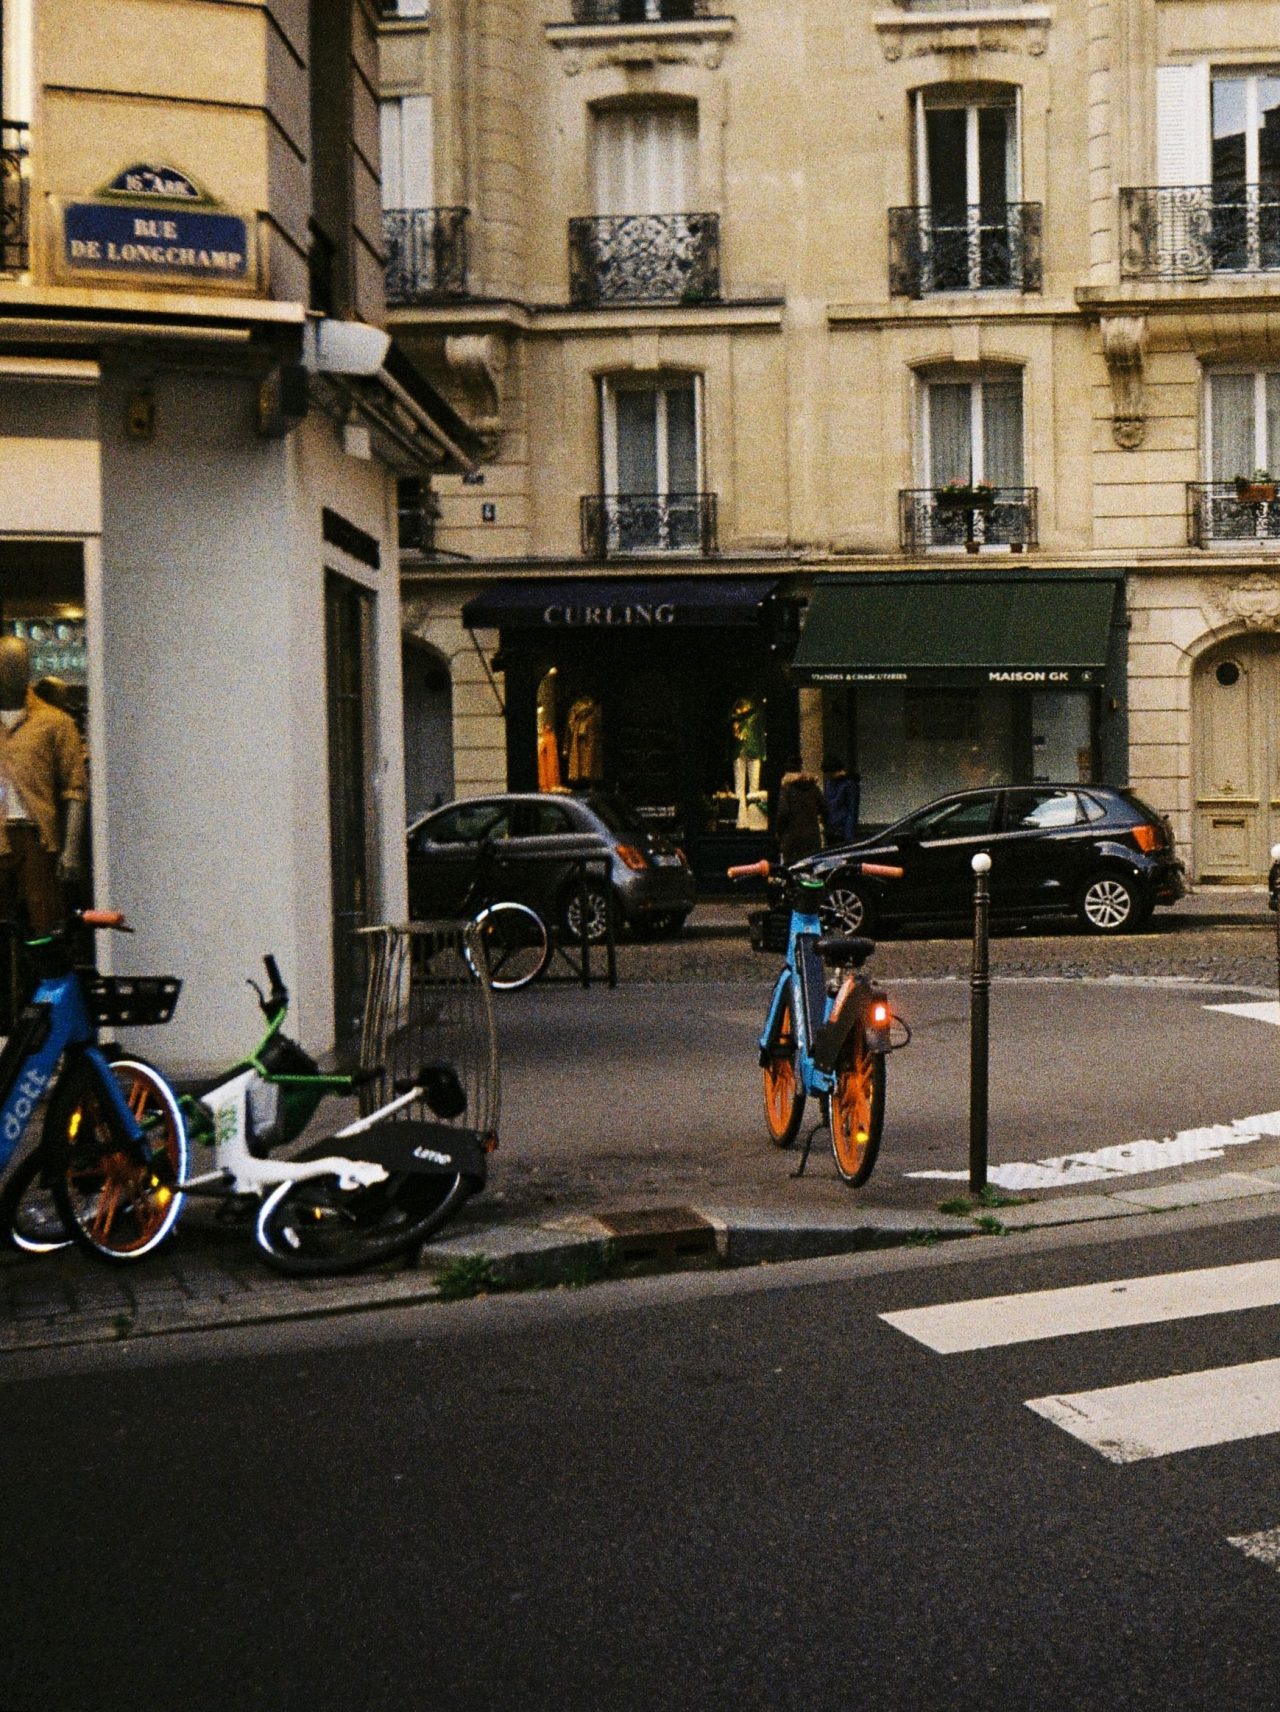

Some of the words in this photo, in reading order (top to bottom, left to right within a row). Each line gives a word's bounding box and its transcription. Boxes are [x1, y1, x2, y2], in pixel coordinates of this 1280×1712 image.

[134, 219, 178, 238] RUE
[71, 240, 101, 258] DE
[107, 242, 241, 269] LONGCHAMP
[543, 603, 675, 624] CURLING
[988, 671, 1047, 681] MAISON
[1048, 671, 1070, 681] GK
[4, 1069, 48, 1140] dott
